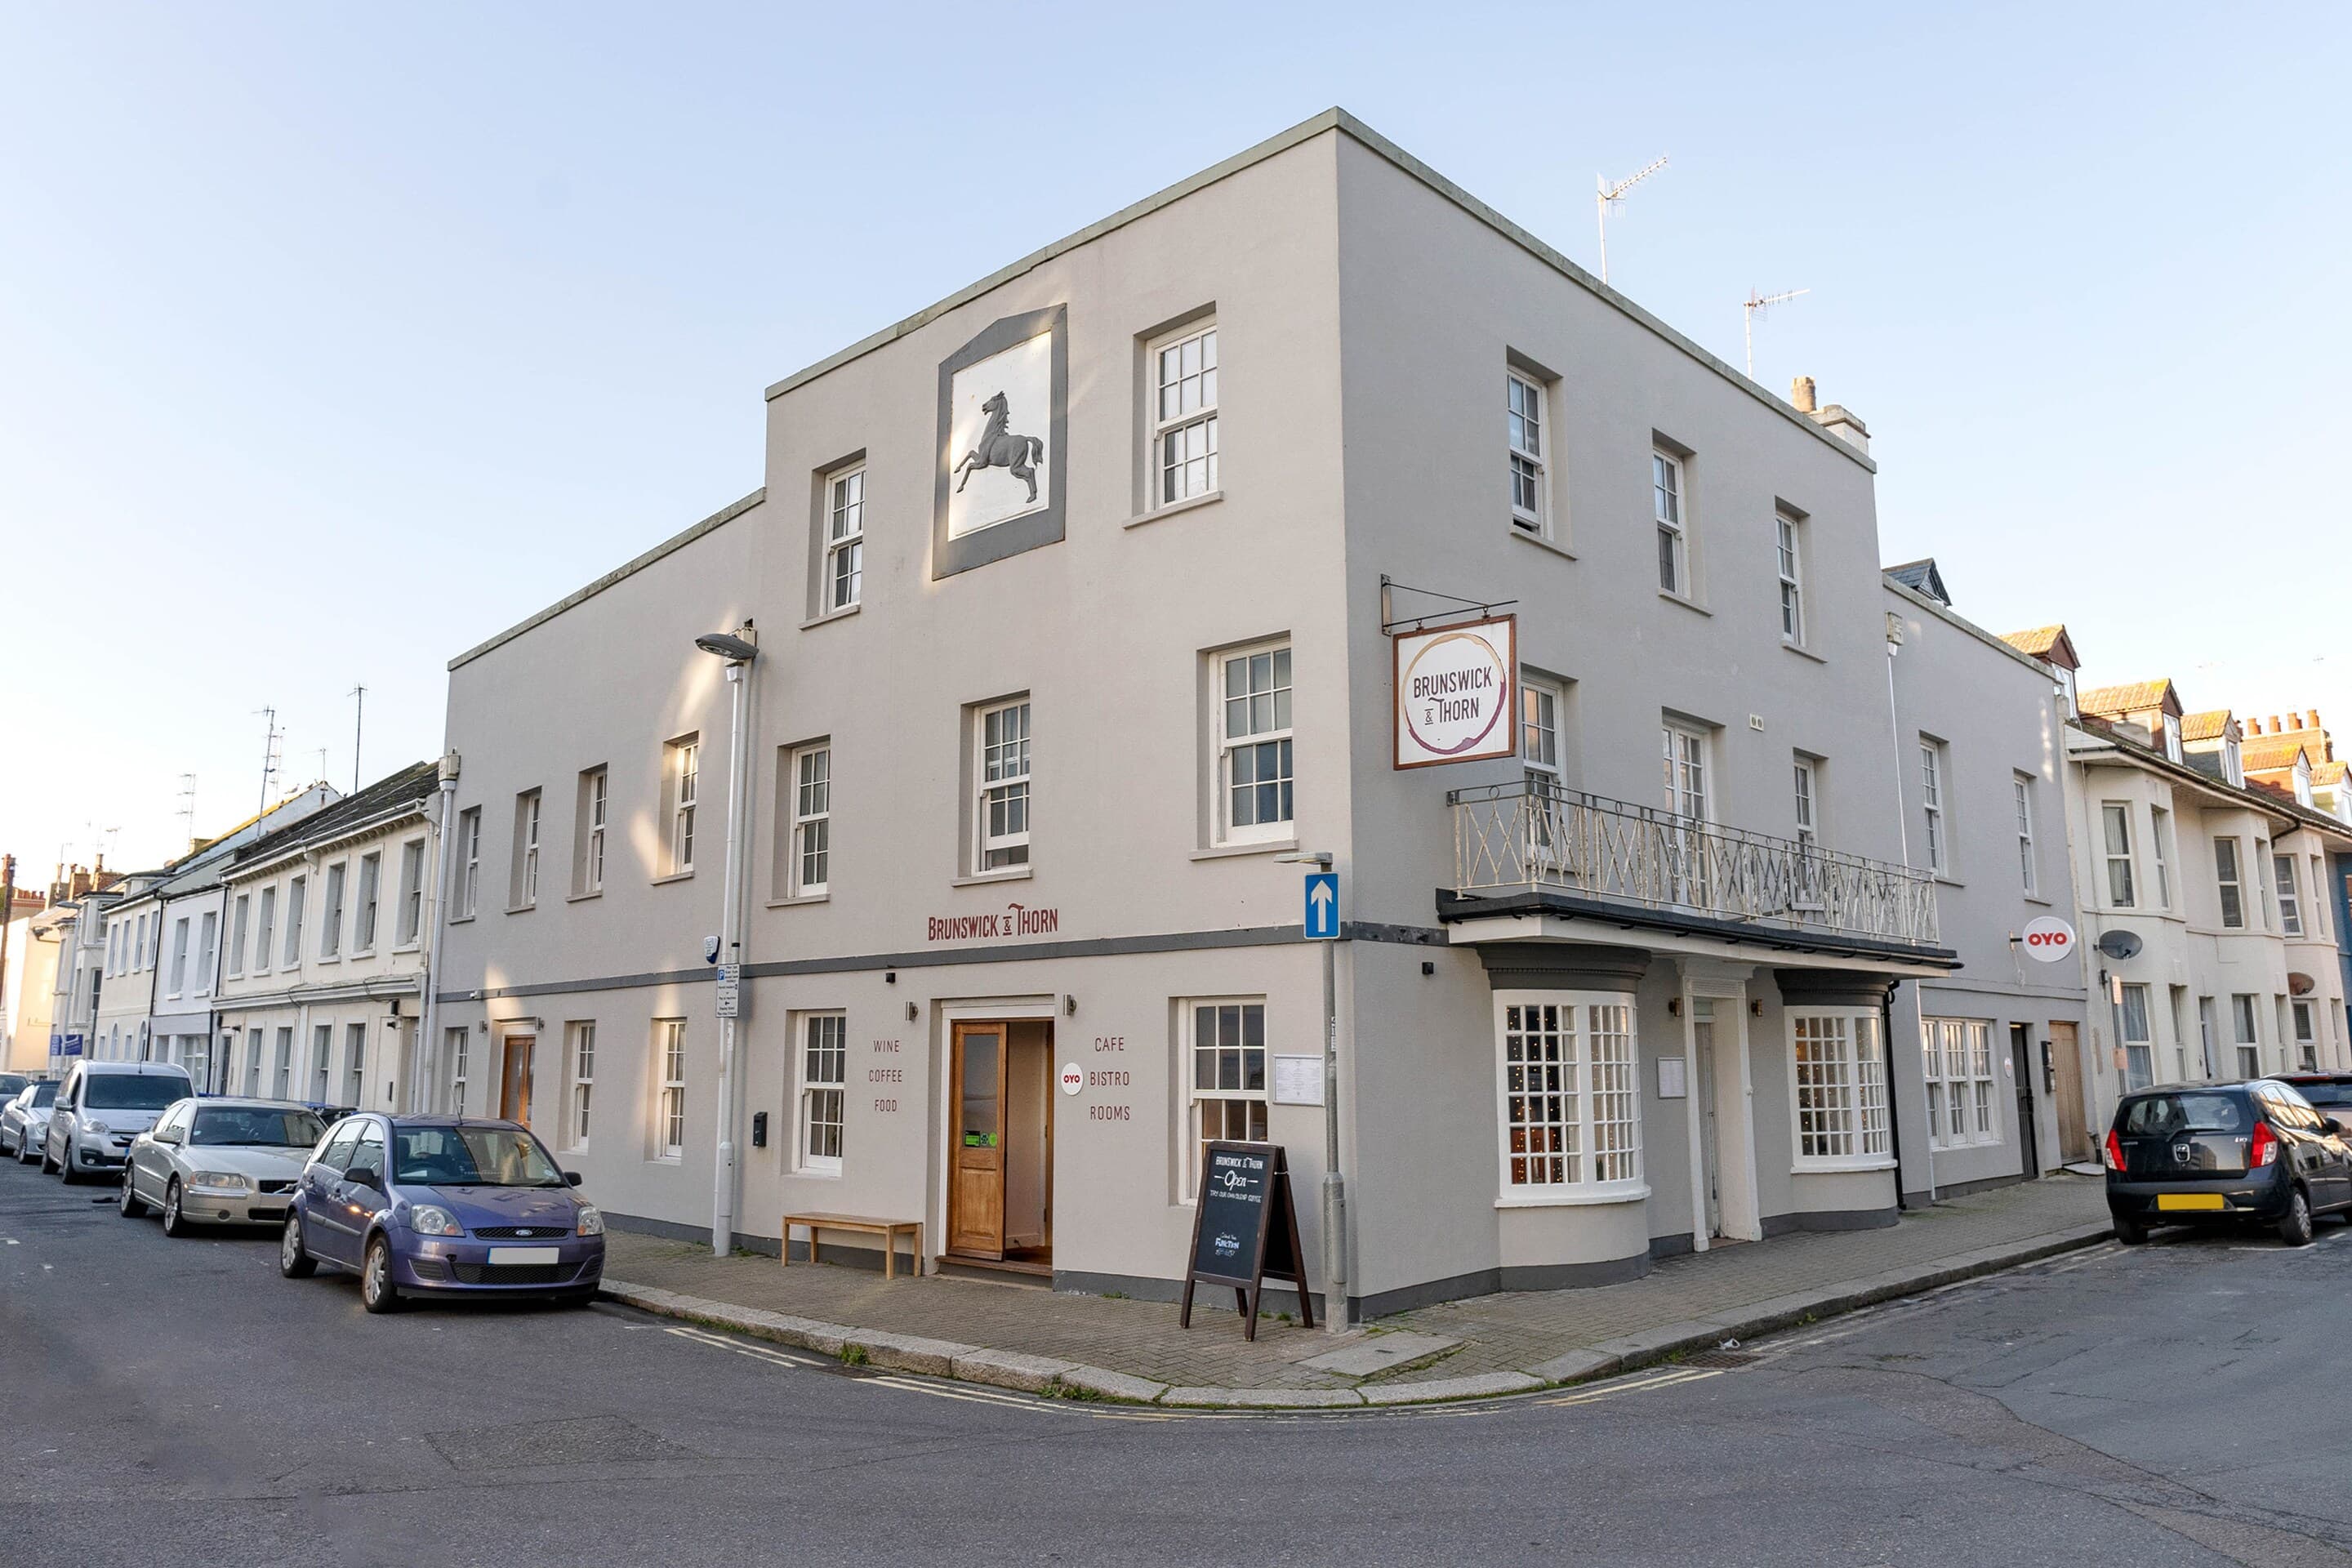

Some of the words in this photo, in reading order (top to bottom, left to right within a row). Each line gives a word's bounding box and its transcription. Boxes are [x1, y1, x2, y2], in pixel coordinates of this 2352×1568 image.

[1414, 666, 1492, 698] BRUNSWICK
[1424, 708, 1434, 725] &
[1428, 697, 1479, 724] THORN
[928, 915, 999, 941] BRUNSWICK
[1003, 915, 1013, 936] &
[1008, 902, 1058, 937] THORN
[2028, 932, 2068, 946] OYO
[873, 1040, 900, 1053] WINE
[1095, 1037, 1125, 1052] CAFE
[869, 1069, 902, 1082] COFFEE
[1063, 1075, 1080, 1083] OYO
[1090, 1071, 1129, 1086] BISTRO
[875, 1098, 898, 1111] FOOD
[1090, 1106, 1130, 1120] ROOMS
[1224, 1170, 1246, 1191] Open
